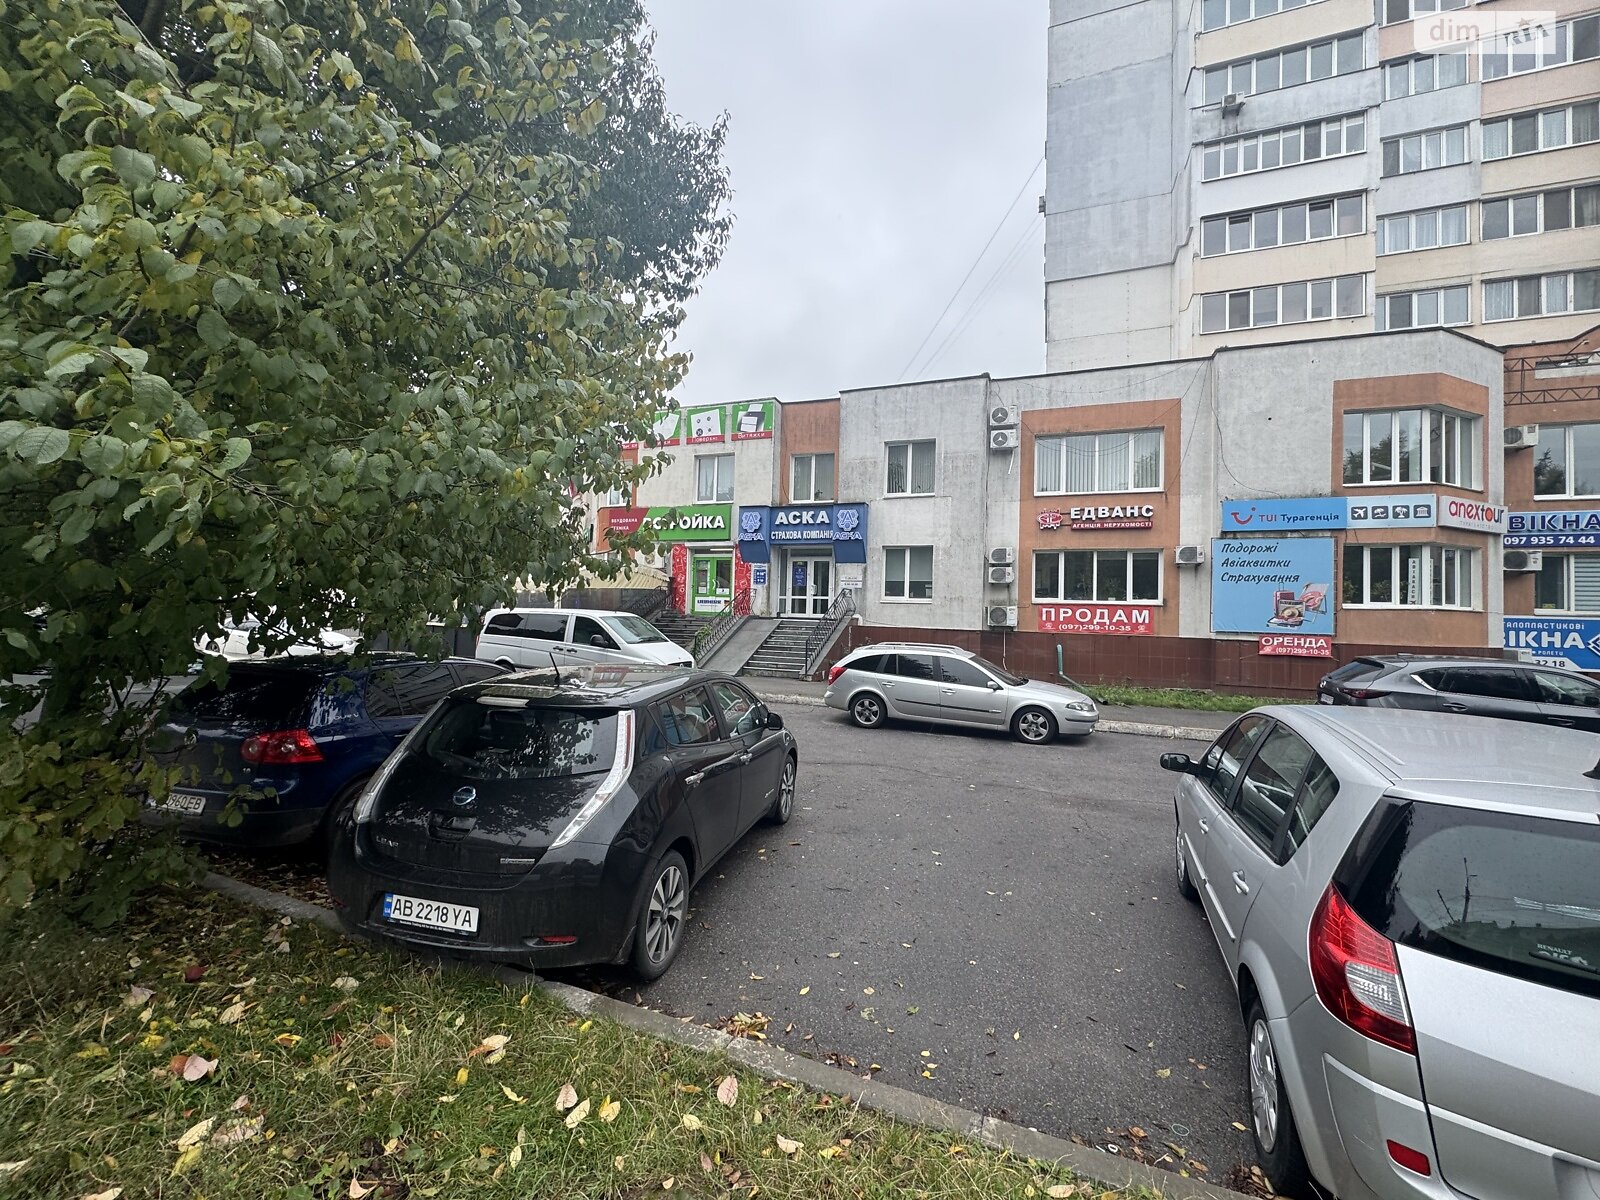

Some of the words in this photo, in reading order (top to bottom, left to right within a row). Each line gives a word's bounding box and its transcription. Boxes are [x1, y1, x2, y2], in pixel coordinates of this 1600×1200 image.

[774, 510, 830, 525] АСКА
[1070, 504, 1154, 521] ЕДВАНС
[1258, 514, 1277, 522] TUI
[1280, 512, 1339, 523] Турагенція
[1449, 500, 1504, 524] anextour
[642, 513, 725, 530] СОЙКА
[1508, 513, 1600, 532] ВІКНА
[770, 530, 802, 540] СТРАХОВА
[802, 530, 833, 540] КОМПАНІЯ
[1504, 536, 1527, 545] 097
[1530, 536, 1554, 545] 935
[1558, 535, 1575, 544] 74
[1577, 535, 1596, 544] 44
[1221, 542, 1279, 555] Подорожі
[1221, 557, 1291, 568] Авіаквитки
[1220, 572, 1300, 585] Страхування
[1041, 607, 1150, 625] ПРОДАМ
[1058, 623, 1132, 632] (097)299-10-35
[1503, 621, 1585, 630] АЛОПЛАСТИКОВІ
[1261, 636, 1328, 649] ОРЕНДА
[1275, 647, 1330, 656] (097)299-10-35
[187, 796, 202, 810] EB
[392, 898, 414, 917] AB
[415, 902, 449, 923] 2218
[453, 907, 472, 928] YA
[1537, 943, 1573, 955] RENAULT
